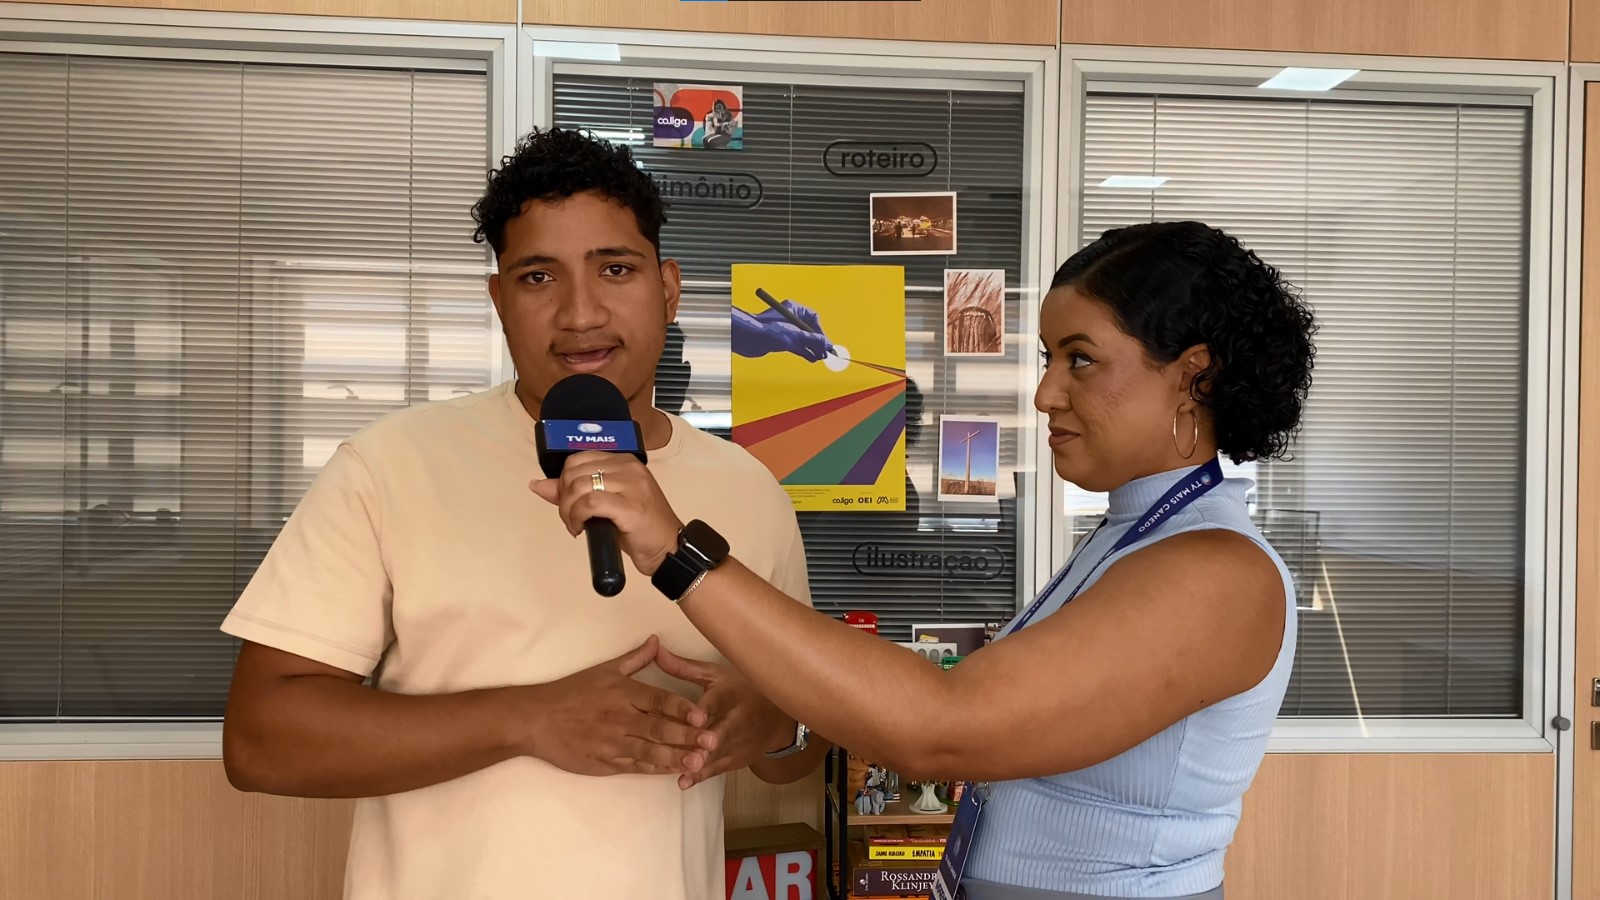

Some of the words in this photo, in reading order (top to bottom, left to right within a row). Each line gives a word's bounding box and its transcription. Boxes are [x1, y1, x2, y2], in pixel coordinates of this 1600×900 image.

[840, 147, 925, 169] roteiro
[585, 435, 616, 443] MAIS
[1189, 480, 1203, 492] TV
[857, 496, 873, 504] OEI
[1170, 486, 1190, 505] MAIS
[1138, 503, 1171, 533] CANEDO
[866, 546, 989, 575] ilustração
[912, 849, 936, 858] EMPATIA
